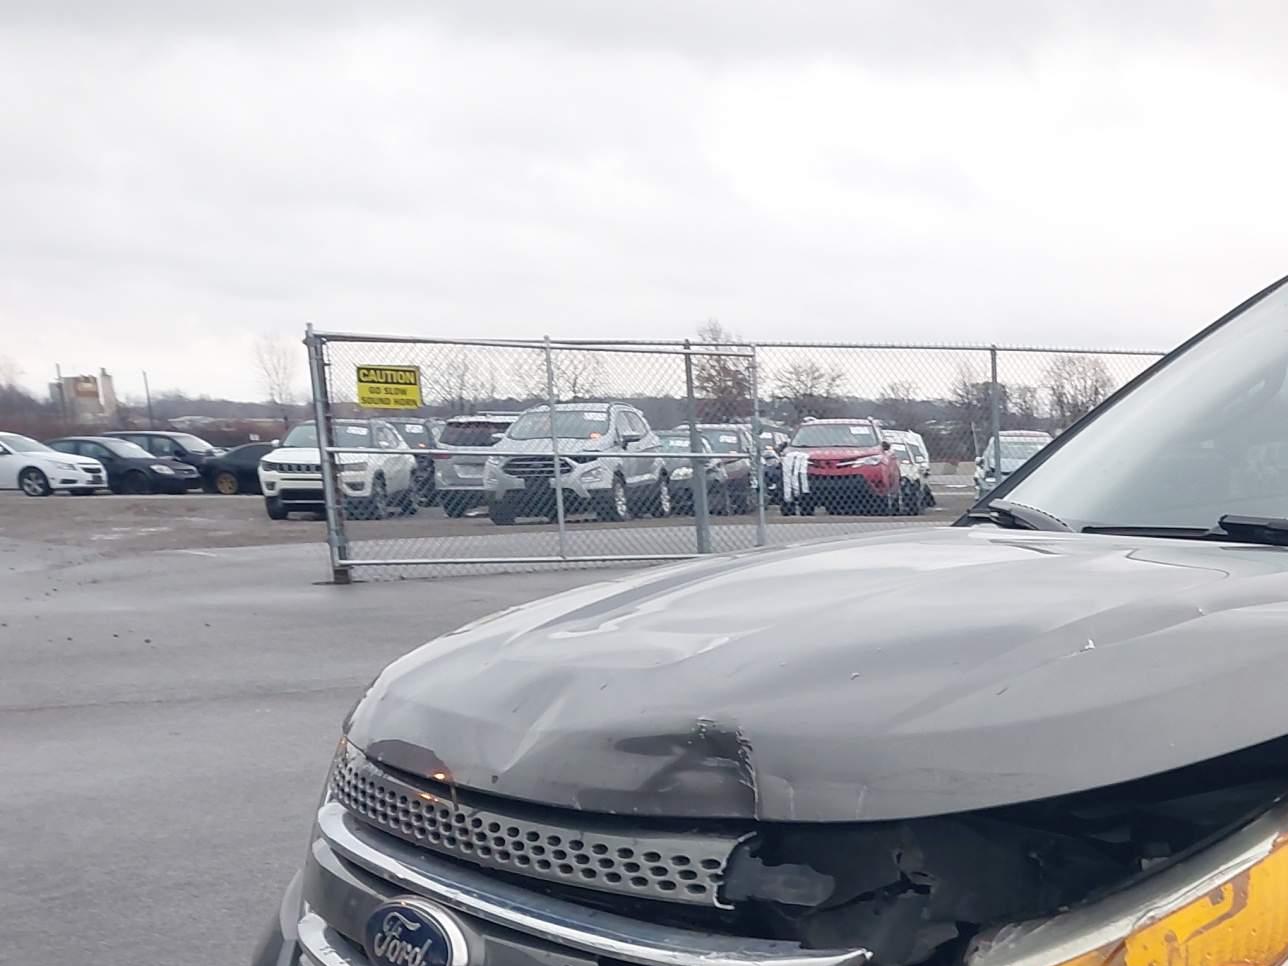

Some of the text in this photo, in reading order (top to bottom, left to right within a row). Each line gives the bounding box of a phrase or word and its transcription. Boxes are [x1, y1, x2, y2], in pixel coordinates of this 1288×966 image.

[360, 368, 416, 384] CAUTION
[368, 386, 407, 395] GO SLOW
[360, 396, 391, 405] SOUND
